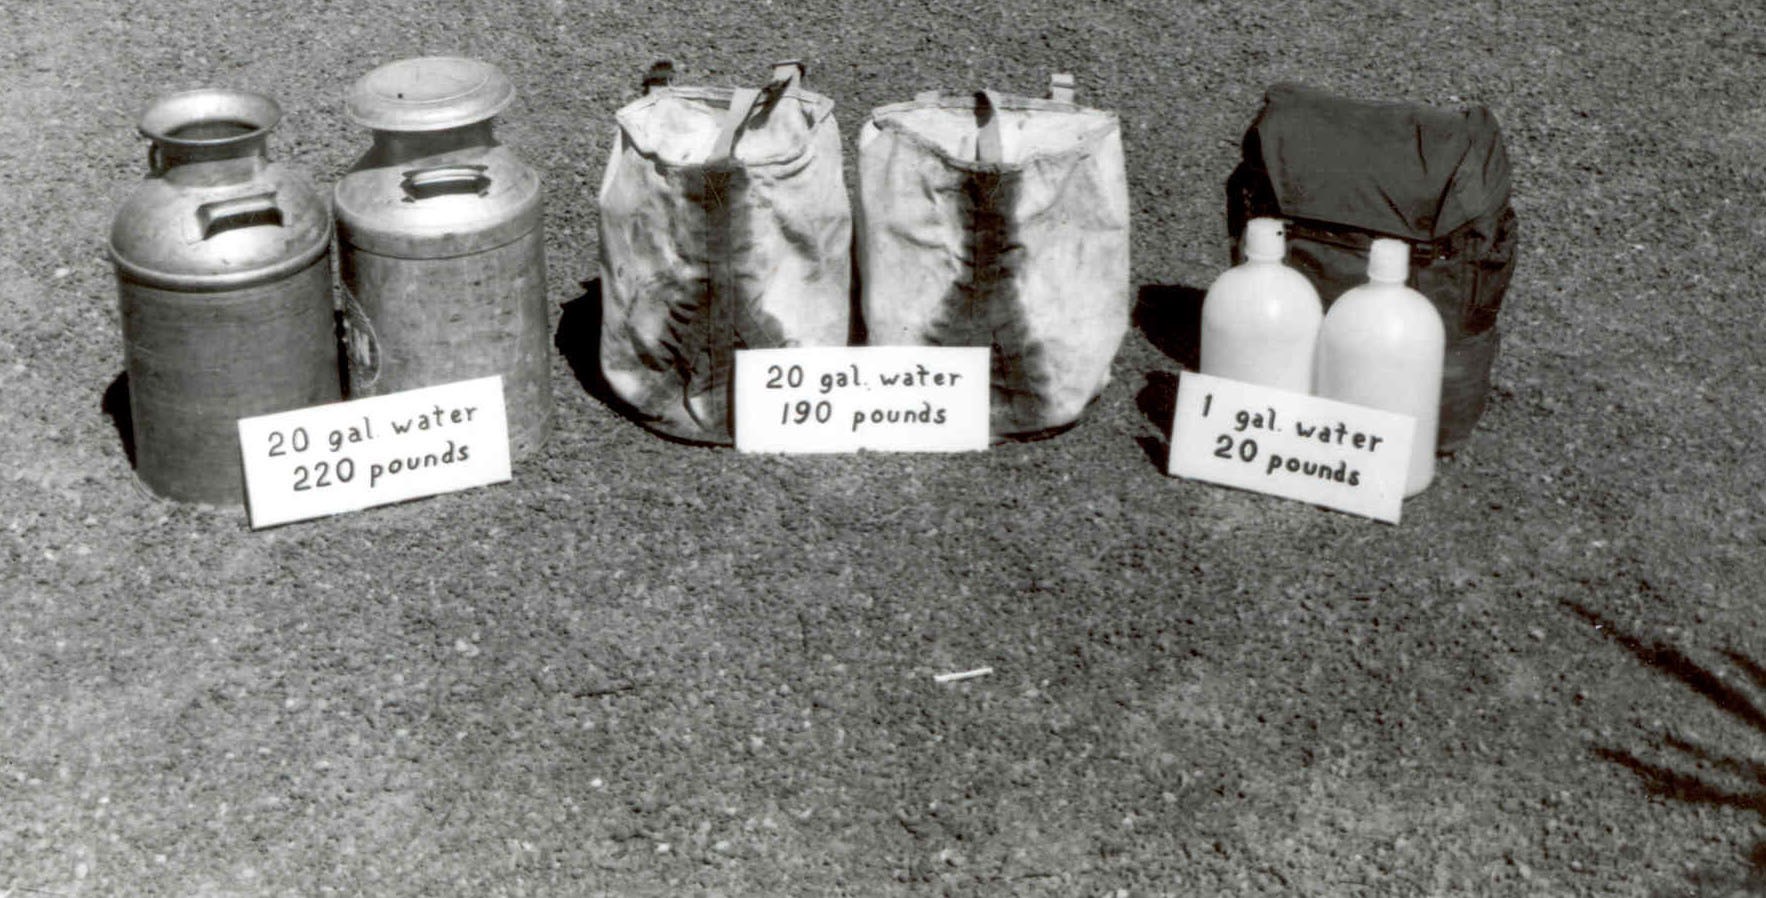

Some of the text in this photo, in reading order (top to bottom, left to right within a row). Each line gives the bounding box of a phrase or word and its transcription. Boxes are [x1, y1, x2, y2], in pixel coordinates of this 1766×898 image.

[766, 364, 804, 389] 20
[879, 364, 963, 387] water
[267, 426, 310, 457] 20
[391, 404, 479, 436] water
[781, 400, 947, 433] 190 pounds
[1202, 393, 1213, 418] 1
[1295, 421, 1384, 452] water
[292, 440, 470, 493] 220 pounds
[1213, 434, 1361, 487] 20 pounds
